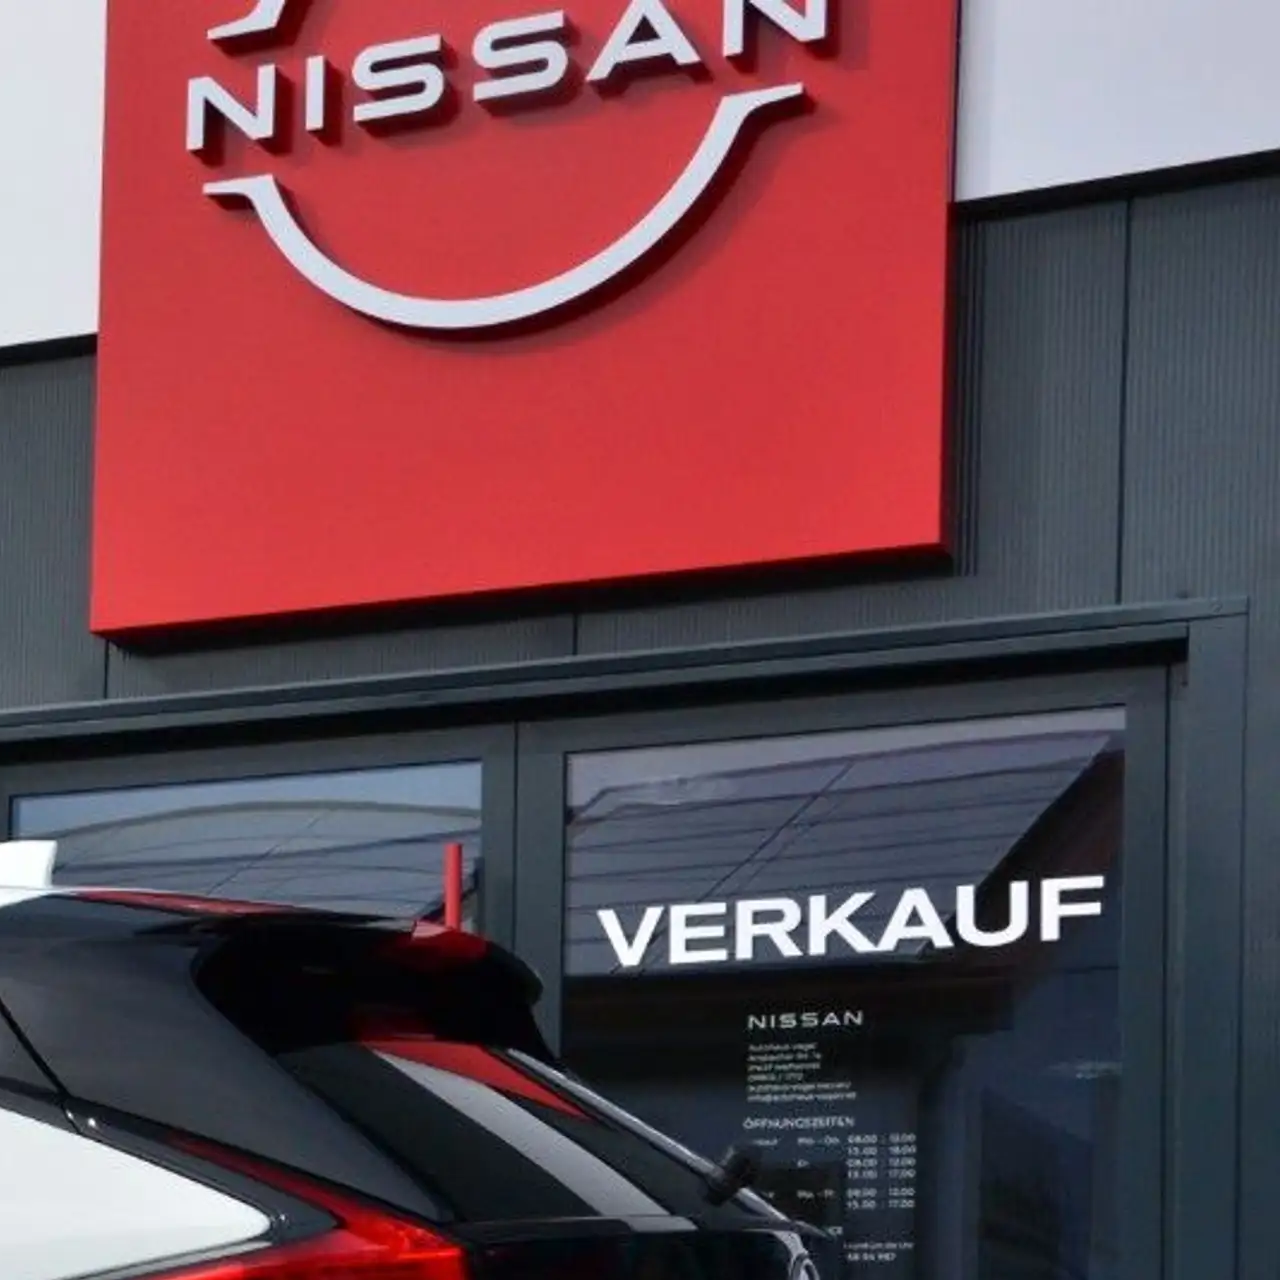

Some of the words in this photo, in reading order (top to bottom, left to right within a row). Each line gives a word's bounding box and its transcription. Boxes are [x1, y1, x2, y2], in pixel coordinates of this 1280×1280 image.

[185, 0, 828, 155] NISSAN
[597, 874, 1105, 968] VERKAUF
[746, 1010, 864, 1029] NISSAN
